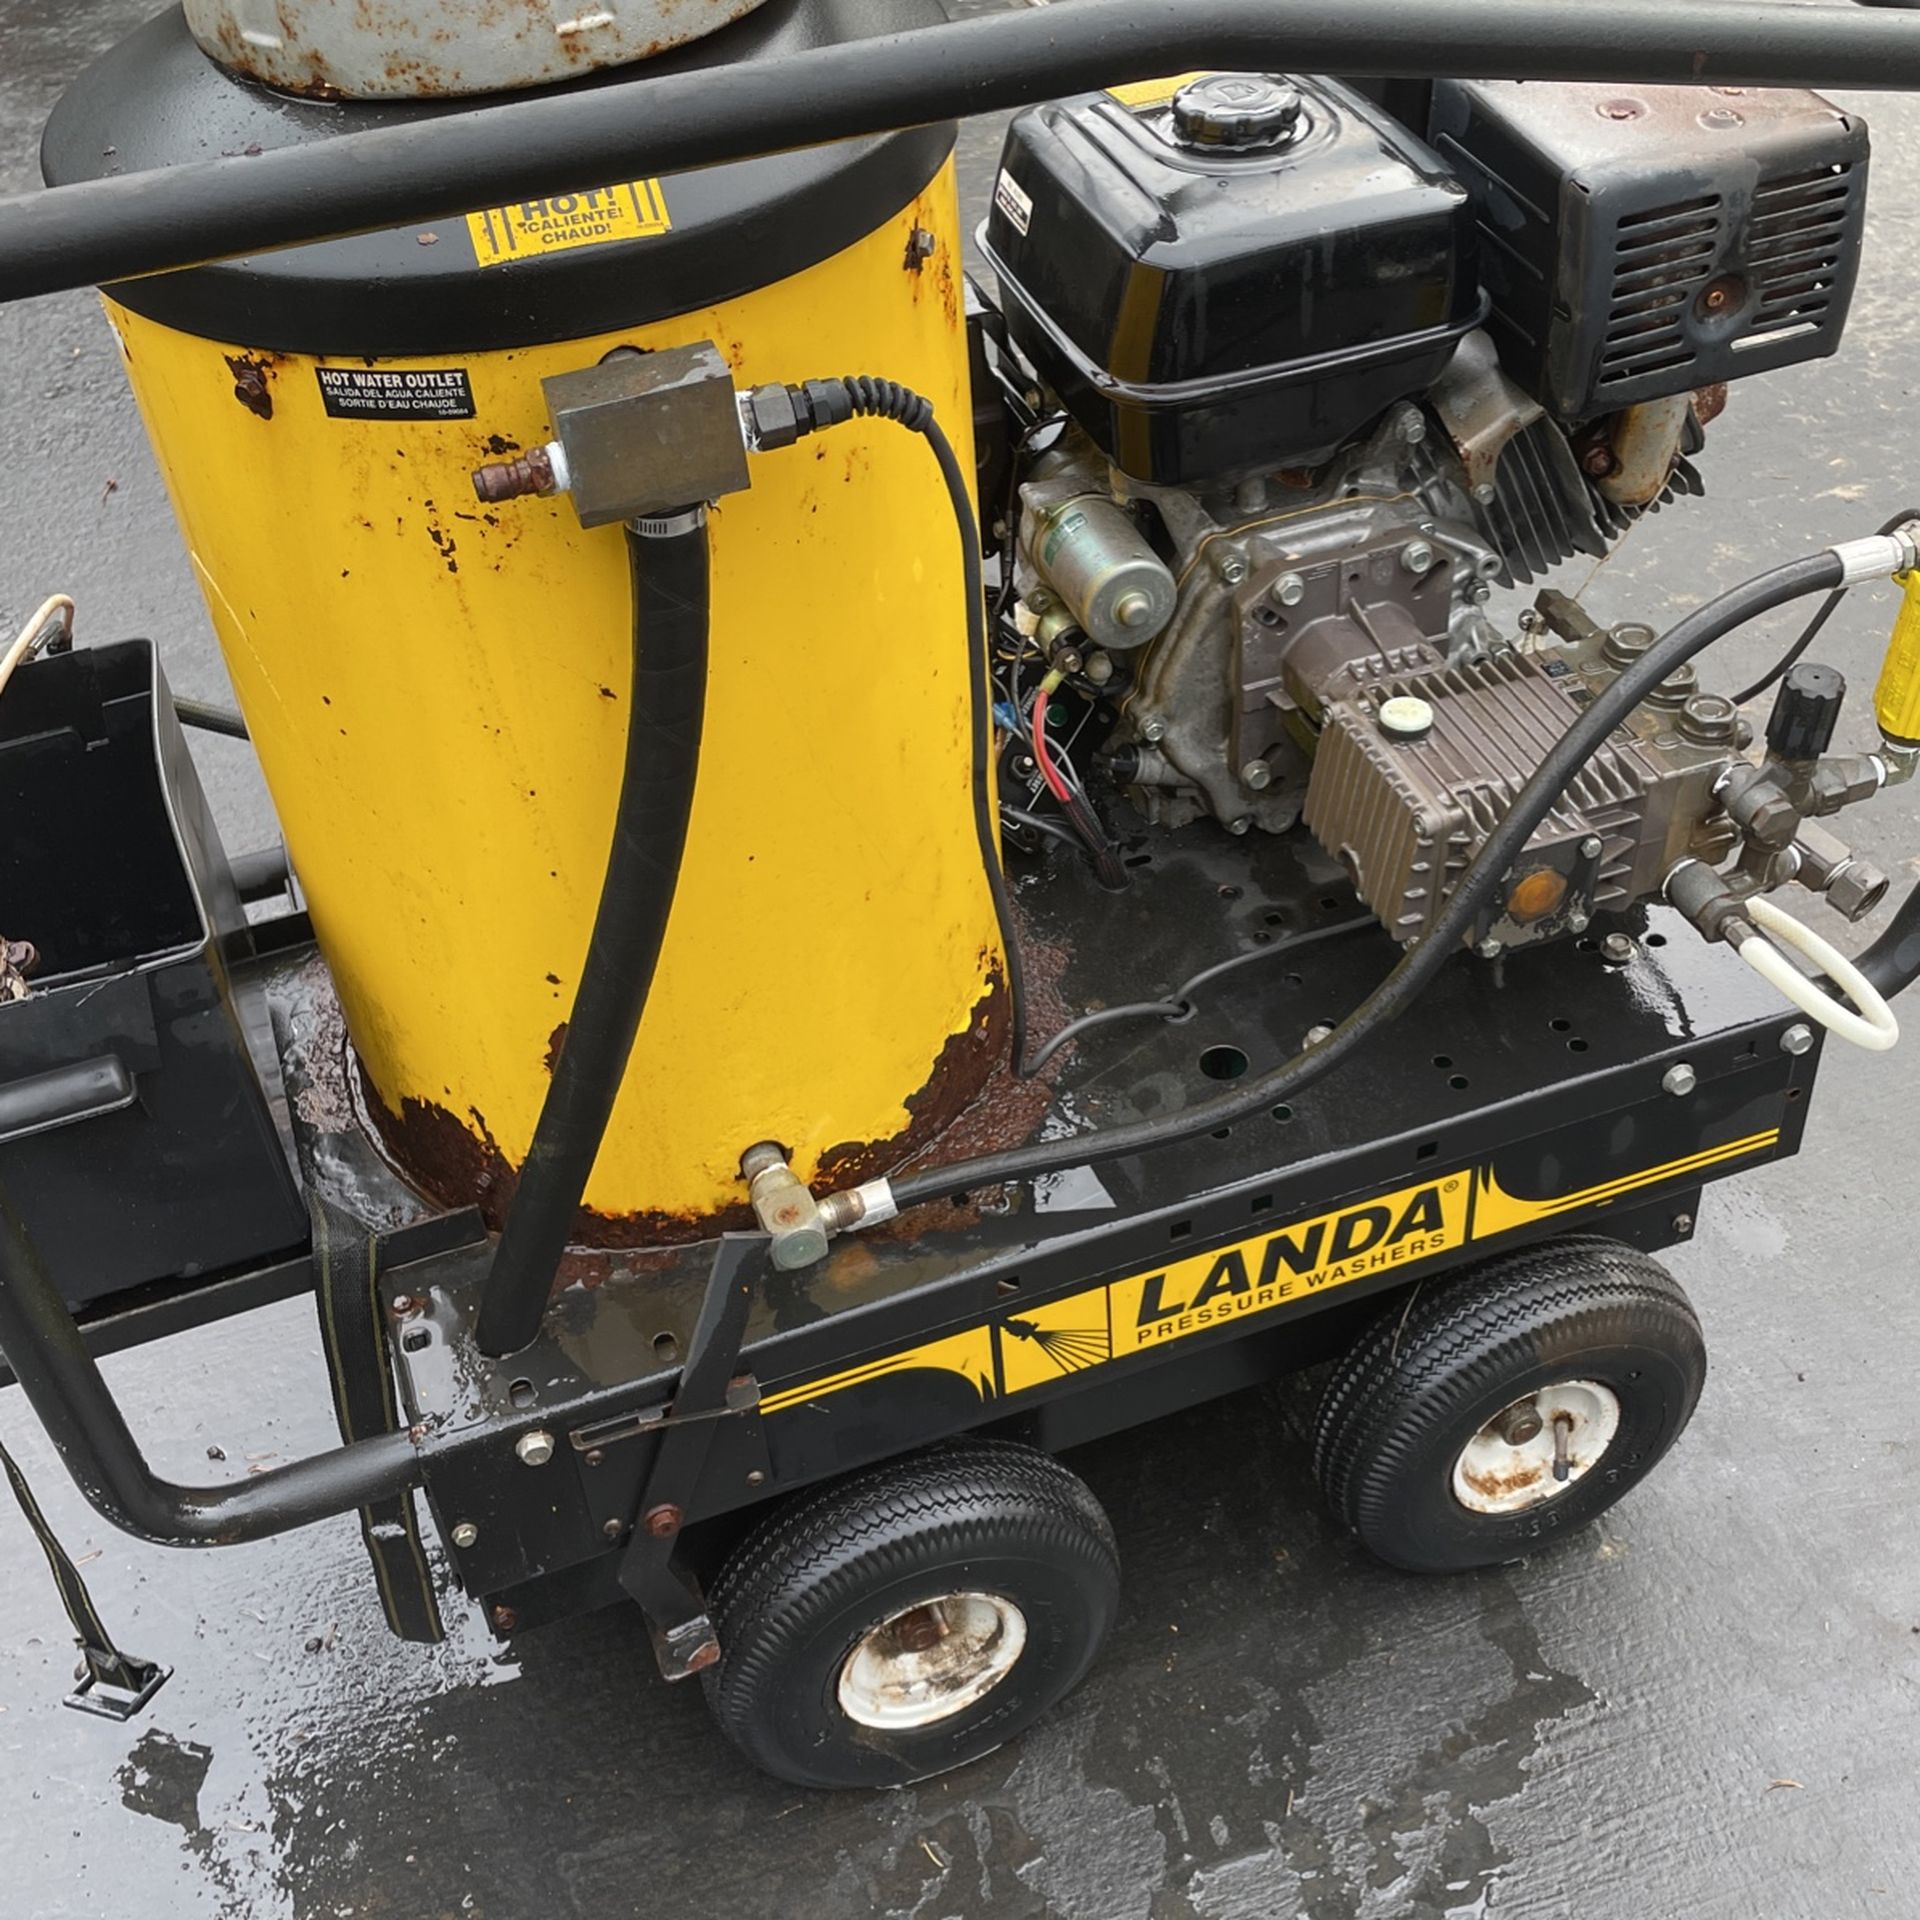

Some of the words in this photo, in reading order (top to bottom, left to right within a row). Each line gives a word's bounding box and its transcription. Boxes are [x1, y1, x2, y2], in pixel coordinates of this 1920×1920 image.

[521, 186, 616, 221] HOT!
[541, 223, 613, 244] CHAUD!
[321, 371, 350, 386] HOT
[353, 373, 403, 388] WATER
[405, 372, 463, 388] OUTLET
[325, 387, 362, 397] SALIDA
[362, 388, 383, 398] DEL
[385, 388, 414, 398] AGUA
[414, 387, 466, 398] CALIENTE
[338, 398, 377, 408] SORTIE
[378, 399, 410, 409] D'EAU
[412, 398, 457, 408] CHAUDE
[1137, 1282, 1293, 1344] PRESSURE
[1306, 1233, 1445, 1288] WASHERS
